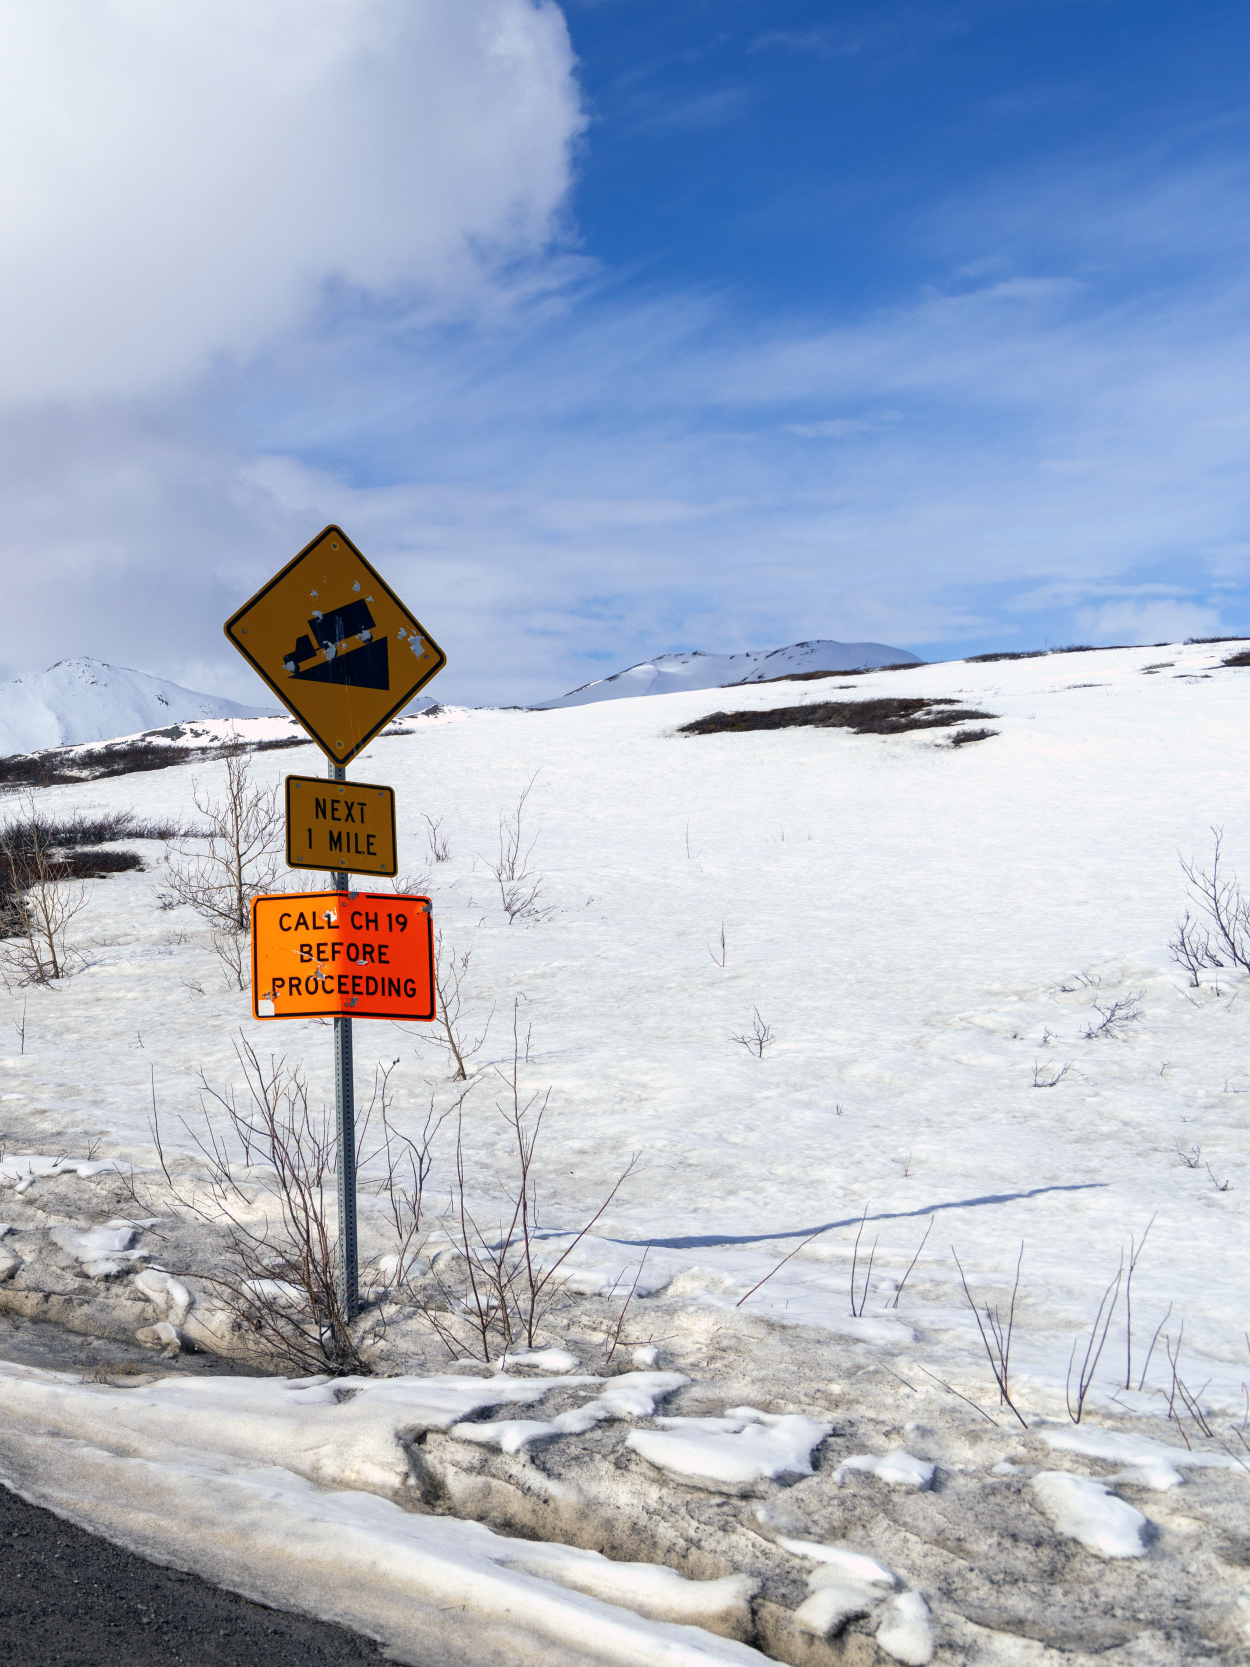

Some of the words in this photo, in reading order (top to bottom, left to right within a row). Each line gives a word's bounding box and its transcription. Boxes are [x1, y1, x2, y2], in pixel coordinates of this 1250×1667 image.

[315, 797, 367, 824] NEXT
[307, 827, 312, 849] 1
[329, 830, 377, 856] MILE
[279, 911, 340, 932] CALL
[351, 911, 379, 931] CH
[387, 913, 408, 932] 19
[300, 942, 390, 964] BEFORE
[272, 974, 417, 998] PROCEEDING
